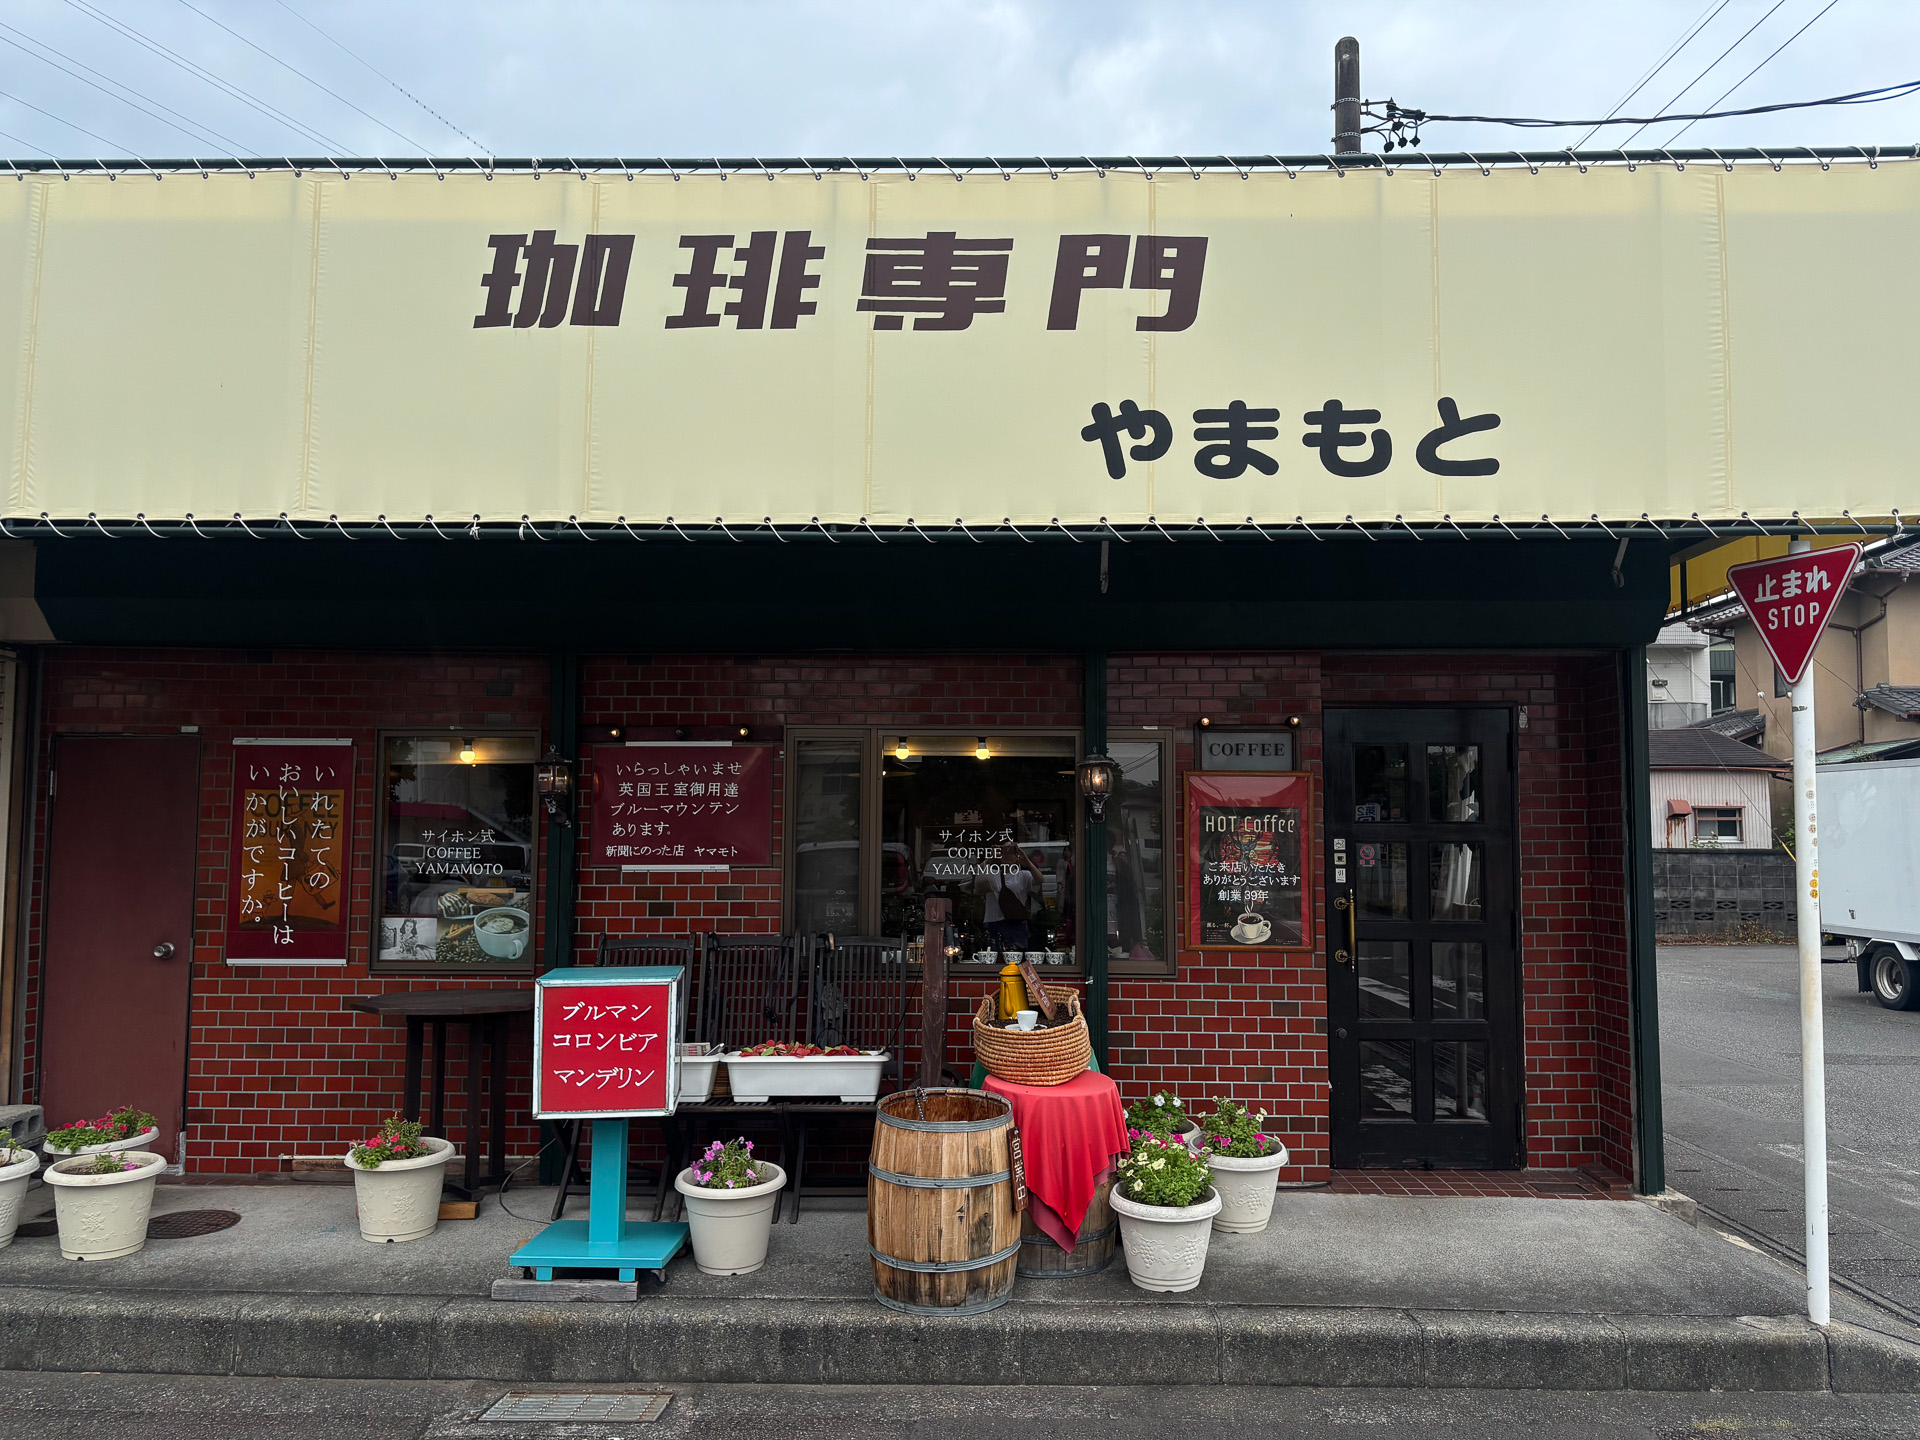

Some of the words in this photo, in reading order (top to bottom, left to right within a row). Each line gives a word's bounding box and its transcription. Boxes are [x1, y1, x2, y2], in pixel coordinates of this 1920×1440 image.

[473, 229, 1209, 332] 珈琲専門
[1081, 396, 1501, 480] やまもと
[1754, 565, 1831, 603] 止まれ
[1768, 602, 1820, 630] STOP
[1209, 743, 1285, 757] COFFEE
[616, 761, 743, 776] いらっしゃいませ
[618, 782, 740, 798] 英国王室御用達
[610, 802, 740, 817] ブルーマウンテン
[309, 765, 335, 889] いれたての
[612, 821, 671, 837] あります。
[1205, 815, 1237, 833] HOT
[1244, 815, 1295, 833] Coffee
[241, 764, 270, 923] いかがですか。
[422, 829, 496, 843] サイホン式
[939, 828, 1014, 843] サイホン式
[273, 763, 301, 945] おいしいコーヒーは
[427, 846, 481, 859] COFFEE
[605, 844, 685, 857] 新聞にのった店
[694, 845, 738, 857] ヤマモト
[948, 847, 1003, 859] COFFEE
[416, 862, 503, 875] YAMAMOTO
[932, 863, 1020, 876] YAMAMOTO
[1208, 861, 1286, 873] ご来店いただき
[1203, 874, 1301, 886] ありがとうございます
[562, 1001, 652, 1021] ブルマン
[552, 1032, 659, 1053] コロンビア
[553, 1066, 655, 1090] マンデリン
[1012, 1136, 1026, 1200] 営業中
